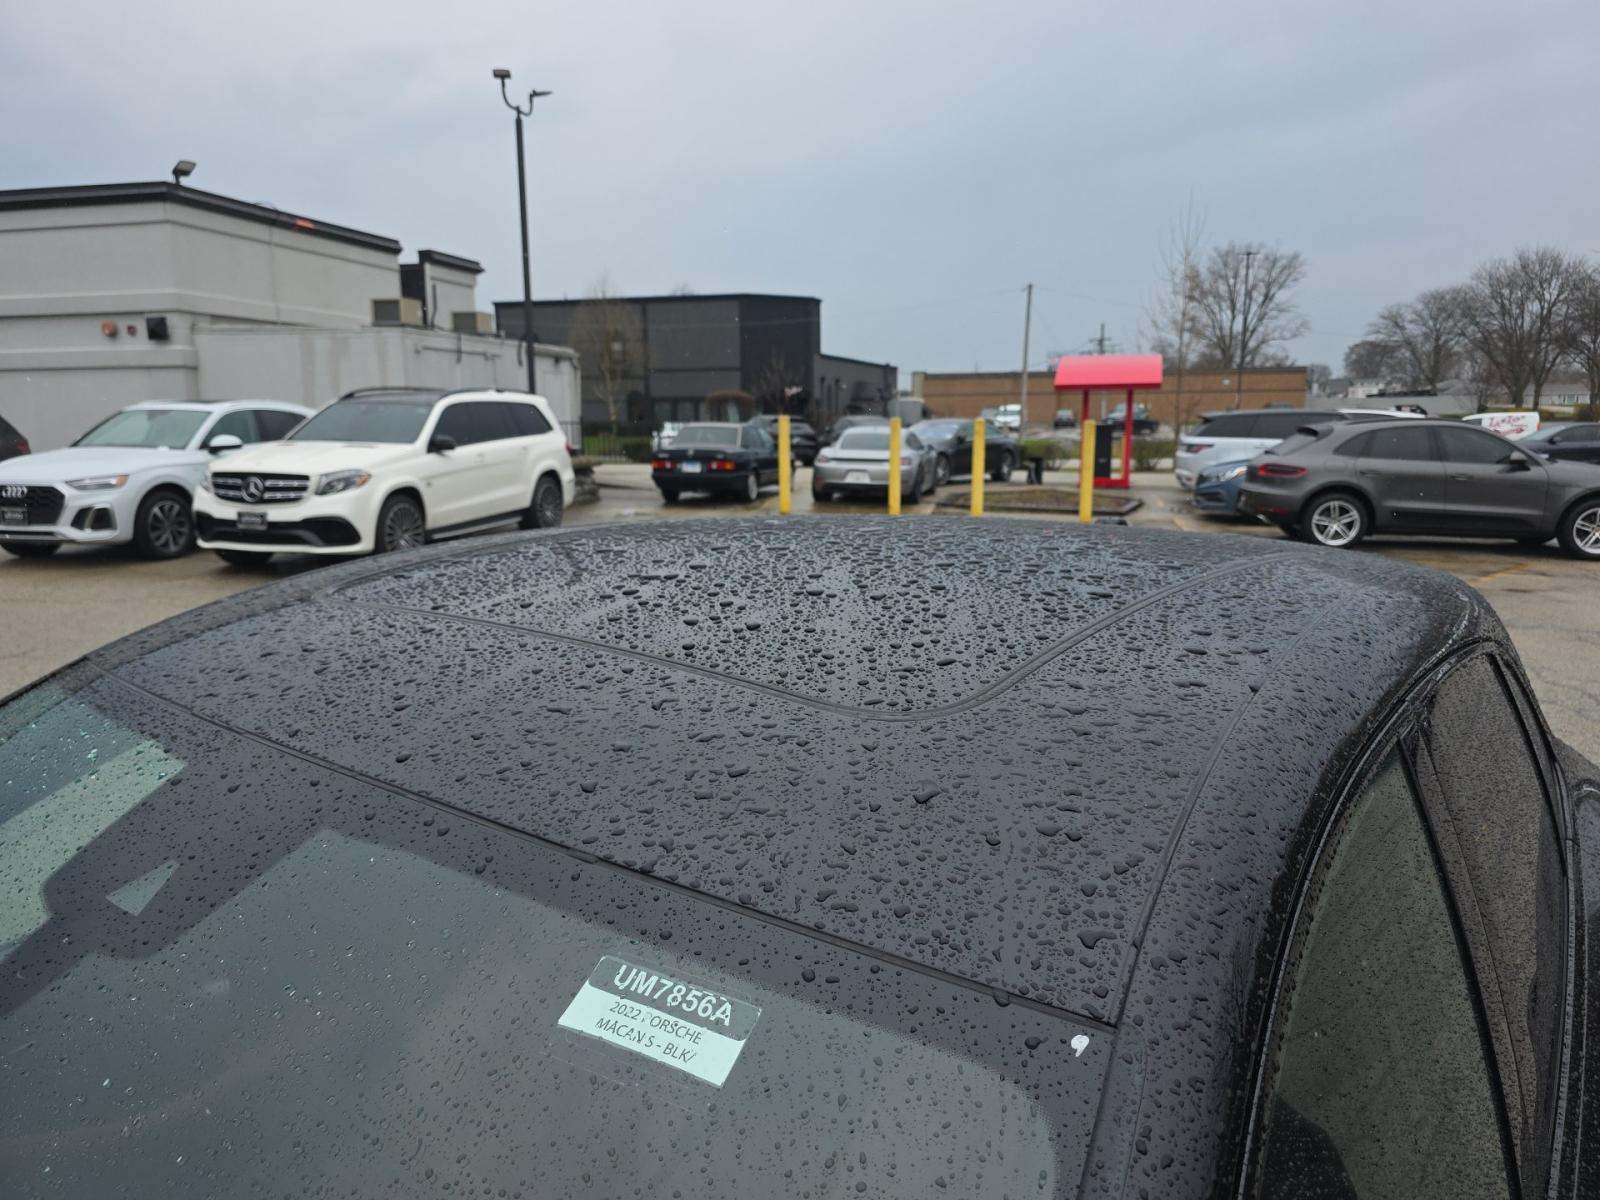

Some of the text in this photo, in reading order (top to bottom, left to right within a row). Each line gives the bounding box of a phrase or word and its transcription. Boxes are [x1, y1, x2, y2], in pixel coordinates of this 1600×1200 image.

[609, 1001, 642, 1020] 2022
[613, 964, 732, 1027] UM7856A
[596, 1017, 645, 1044] MACAN
[645, 1035, 655, 1048] S
